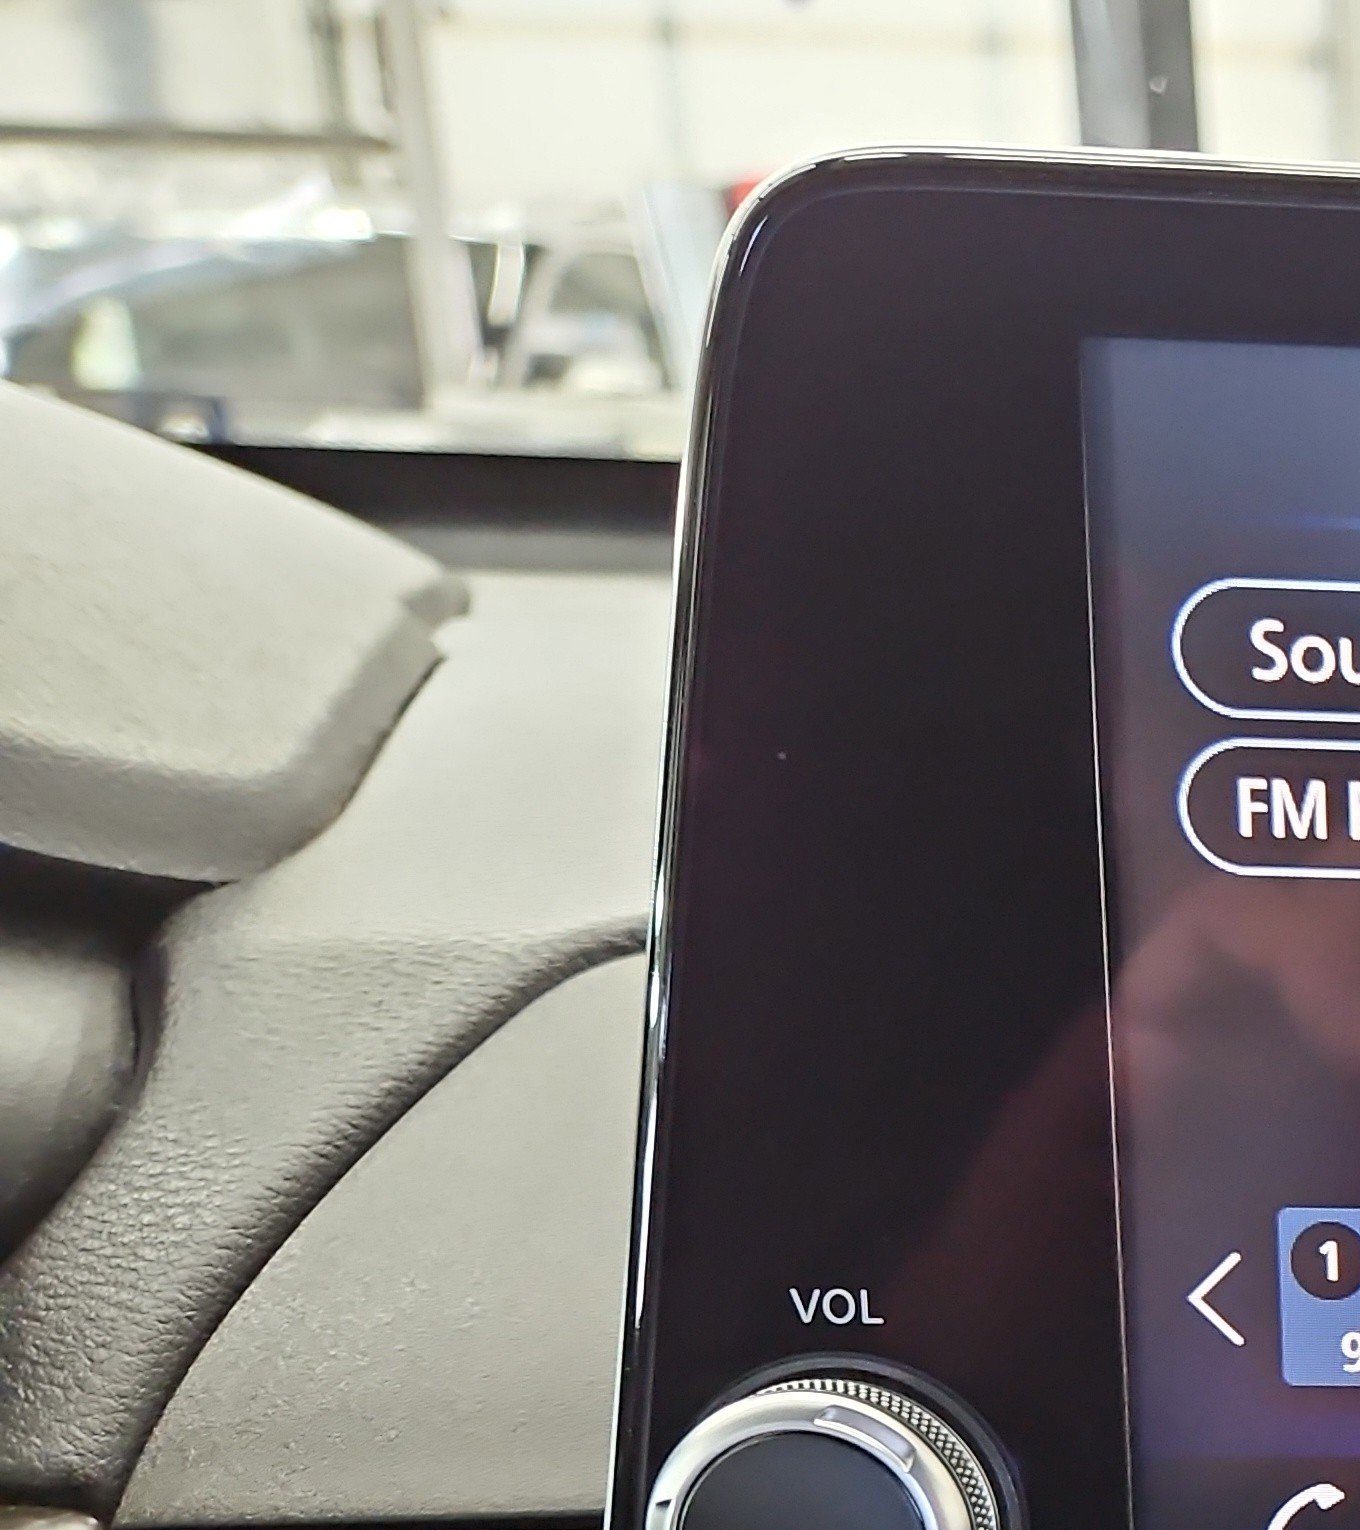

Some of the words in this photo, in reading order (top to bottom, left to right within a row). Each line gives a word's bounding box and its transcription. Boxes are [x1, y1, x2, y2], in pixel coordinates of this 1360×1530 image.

[1236, 777, 1328, 840] FM
[1318, 1240, 1339, 1282] 1
[789, 1288, 885, 1325] VOL
